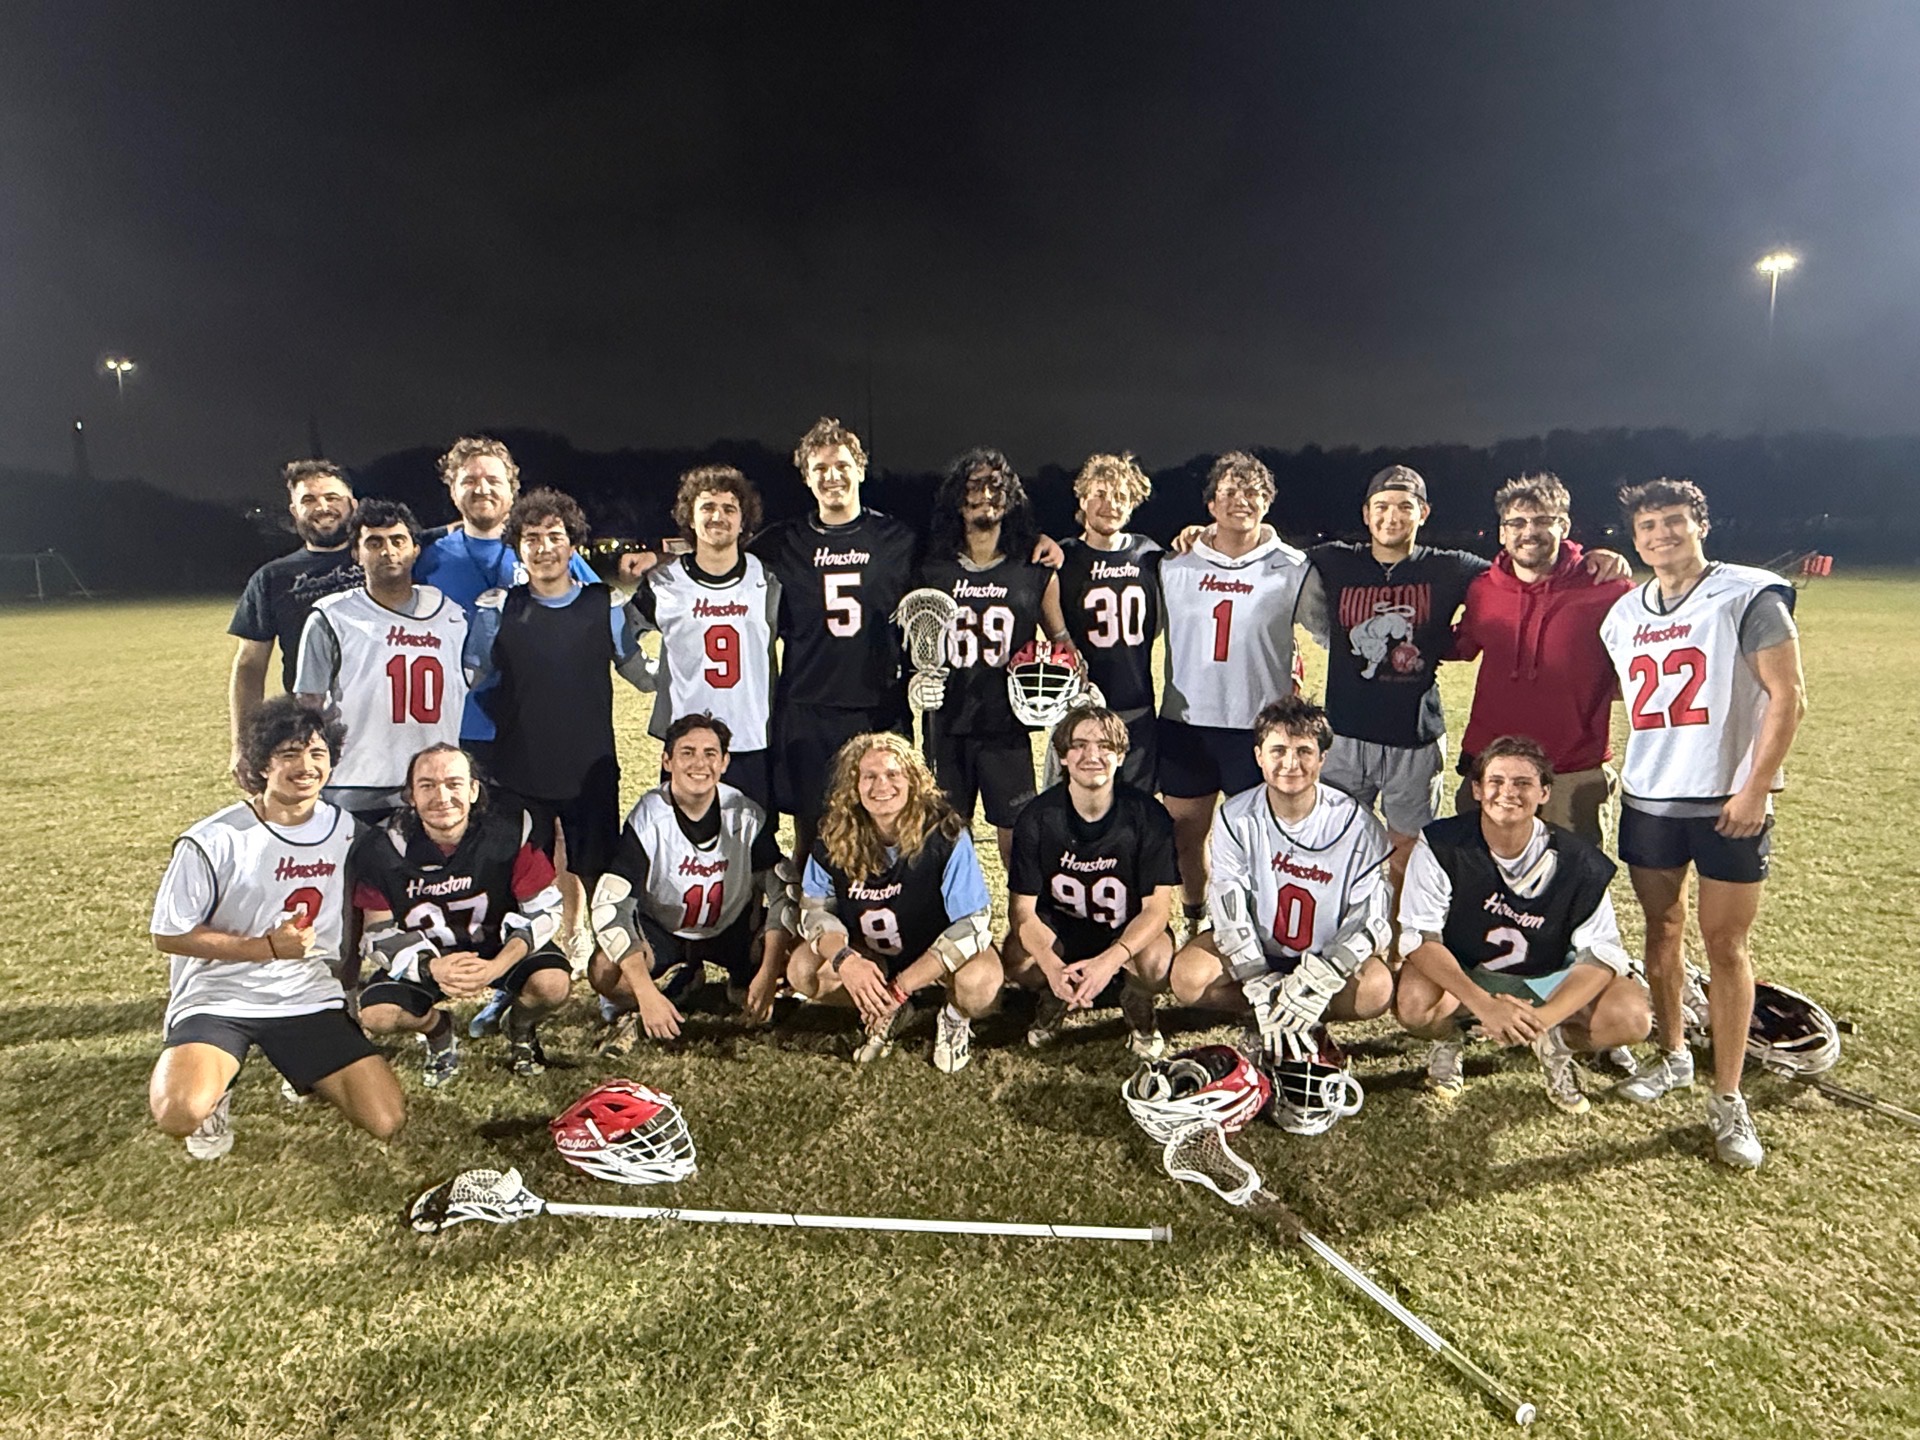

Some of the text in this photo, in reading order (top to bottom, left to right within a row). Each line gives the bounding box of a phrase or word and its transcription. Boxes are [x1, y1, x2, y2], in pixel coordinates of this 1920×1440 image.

[813, 547, 871, 567] Houston
[1090, 561, 1141, 580] Houston
[952, 579, 1008, 600] Houston
[1198, 573, 1255, 597] Houston
[692, 598, 749, 619] Houston
[822, 571, 863, 639] 5
[1083, 585, 1147, 649] 30
[386, 625, 442, 648] Houston
[950, 604, 1016, 670] 69
[1212, 599, 1233, 663] 1
[1632, 621, 1694, 646] Houston
[703, 624, 742, 689] 9
[386, 654, 444, 724] 10
[1628, 647, 1709, 731] 22
[274, 855, 337, 882] Houston
[678, 855, 729, 878] Houston
[1060, 850, 1118, 873] Houston
[1270, 851, 1334, 886] Houston
[406, 875, 473, 899] Houston
[681, 880, 726, 929] 11
[849, 880, 902, 901] Houston
[1051, 872, 1128, 929] 99
[1273, 882, 1317, 952] 0
[1483, 891, 1546, 930] Houston
[860, 908, 902, 956] 8
[1483, 926, 1529, 971] 2
[555, 1129, 598, 1152] Cougars
